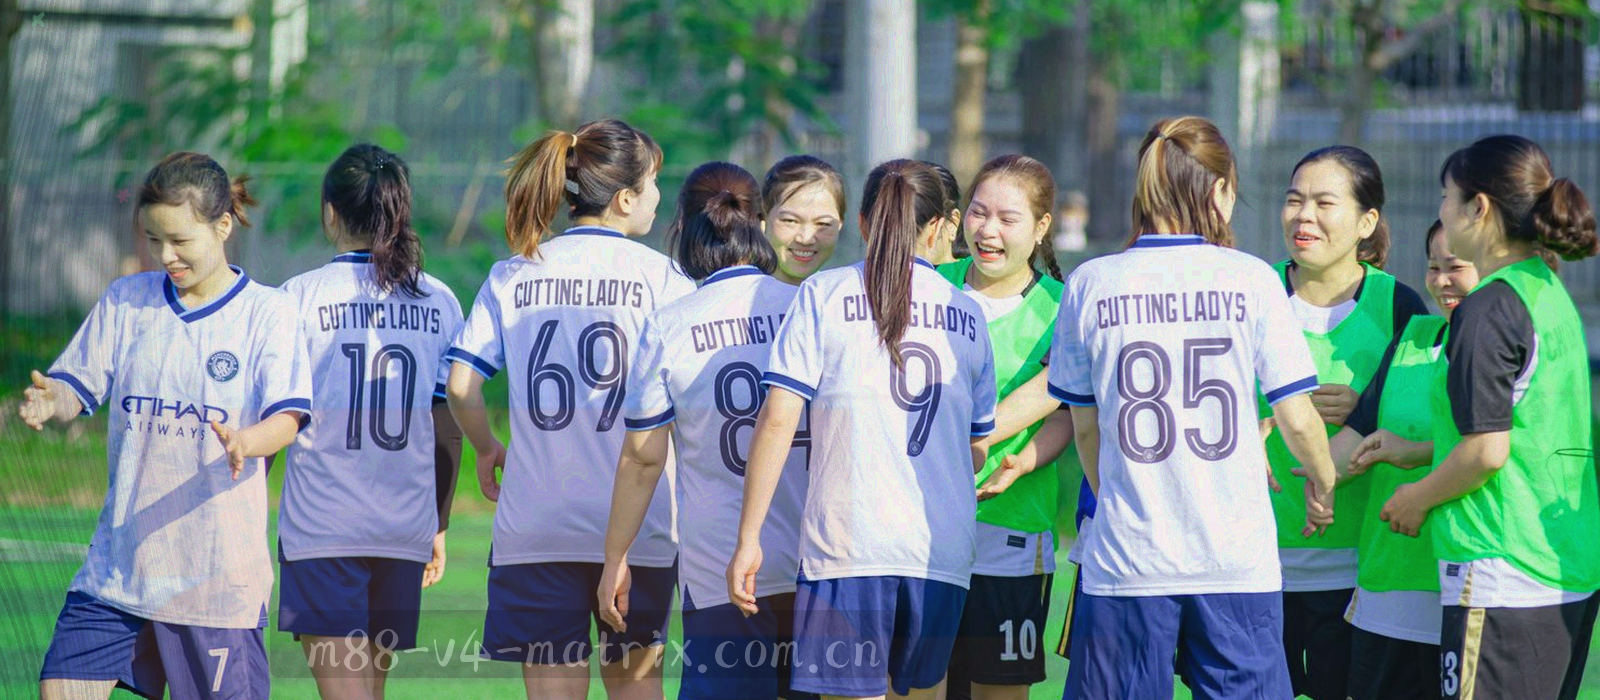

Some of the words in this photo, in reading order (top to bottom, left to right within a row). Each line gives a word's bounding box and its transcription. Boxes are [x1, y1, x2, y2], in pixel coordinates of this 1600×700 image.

[514, 278, 583, 309] CUTTING
[586, 279, 643, 308] LADYS
[1097, 293, 1178, 329] CUTTING
[1182, 291, 1246, 323] LADYS
[318, 302, 386, 332] CUTTING
[389, 303, 441, 334] LADYS
[691, 315, 768, 354] CUTTING
[923, 302, 976, 343] LADYS
[527, 320, 628, 432] 69
[122, 395, 229, 425] ETIHAD
[341, 343, 417, 452] 10
[890, 341, 942, 458] 9
[1117, 337, 1239, 465] 85
[125, 420, 205, 441] AIRWAYS
[999, 618, 1037, 662] 10
[207, 647, 229, 693] 7
